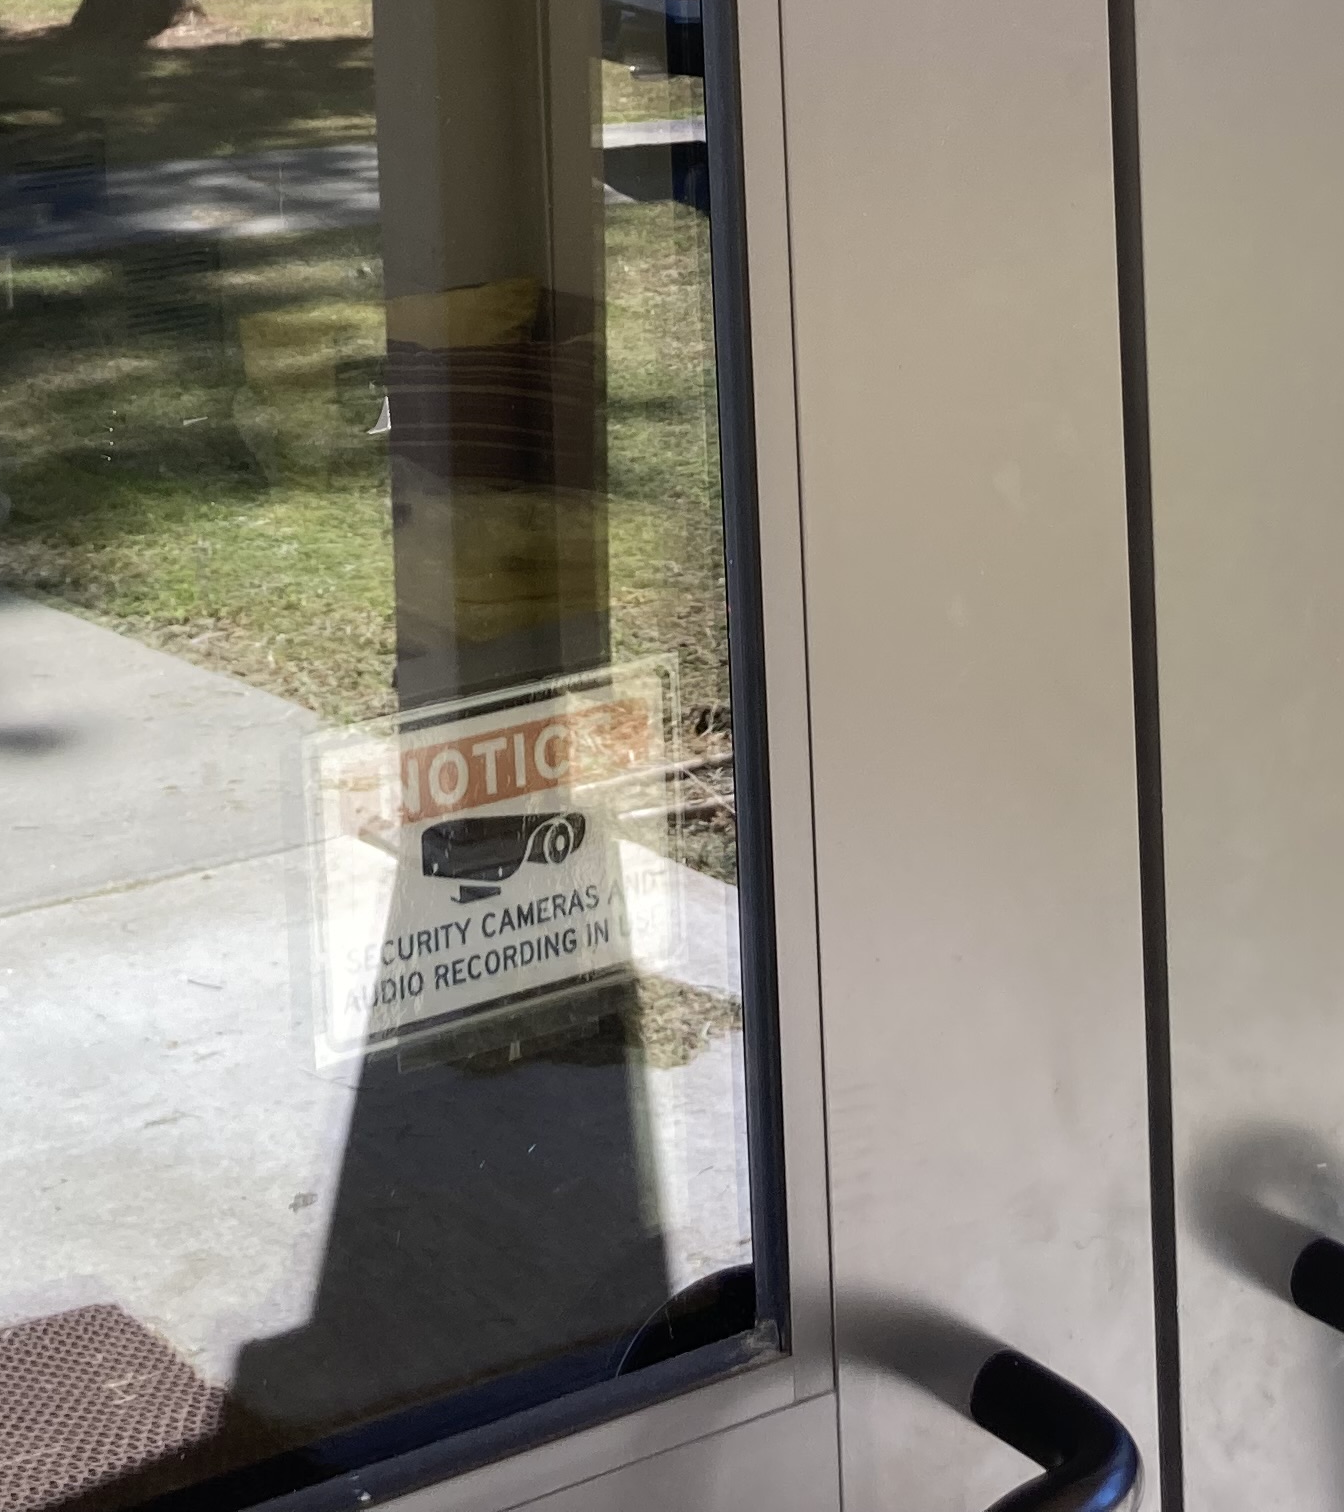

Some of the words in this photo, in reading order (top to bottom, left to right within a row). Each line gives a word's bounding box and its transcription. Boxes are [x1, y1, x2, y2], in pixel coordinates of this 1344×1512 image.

[379, 713, 611, 821] NOTIC
[482, 884, 600, 940] CAMERAS
[434, 927, 577, 992] RECORDING
[586, 917, 609, 947] IN
